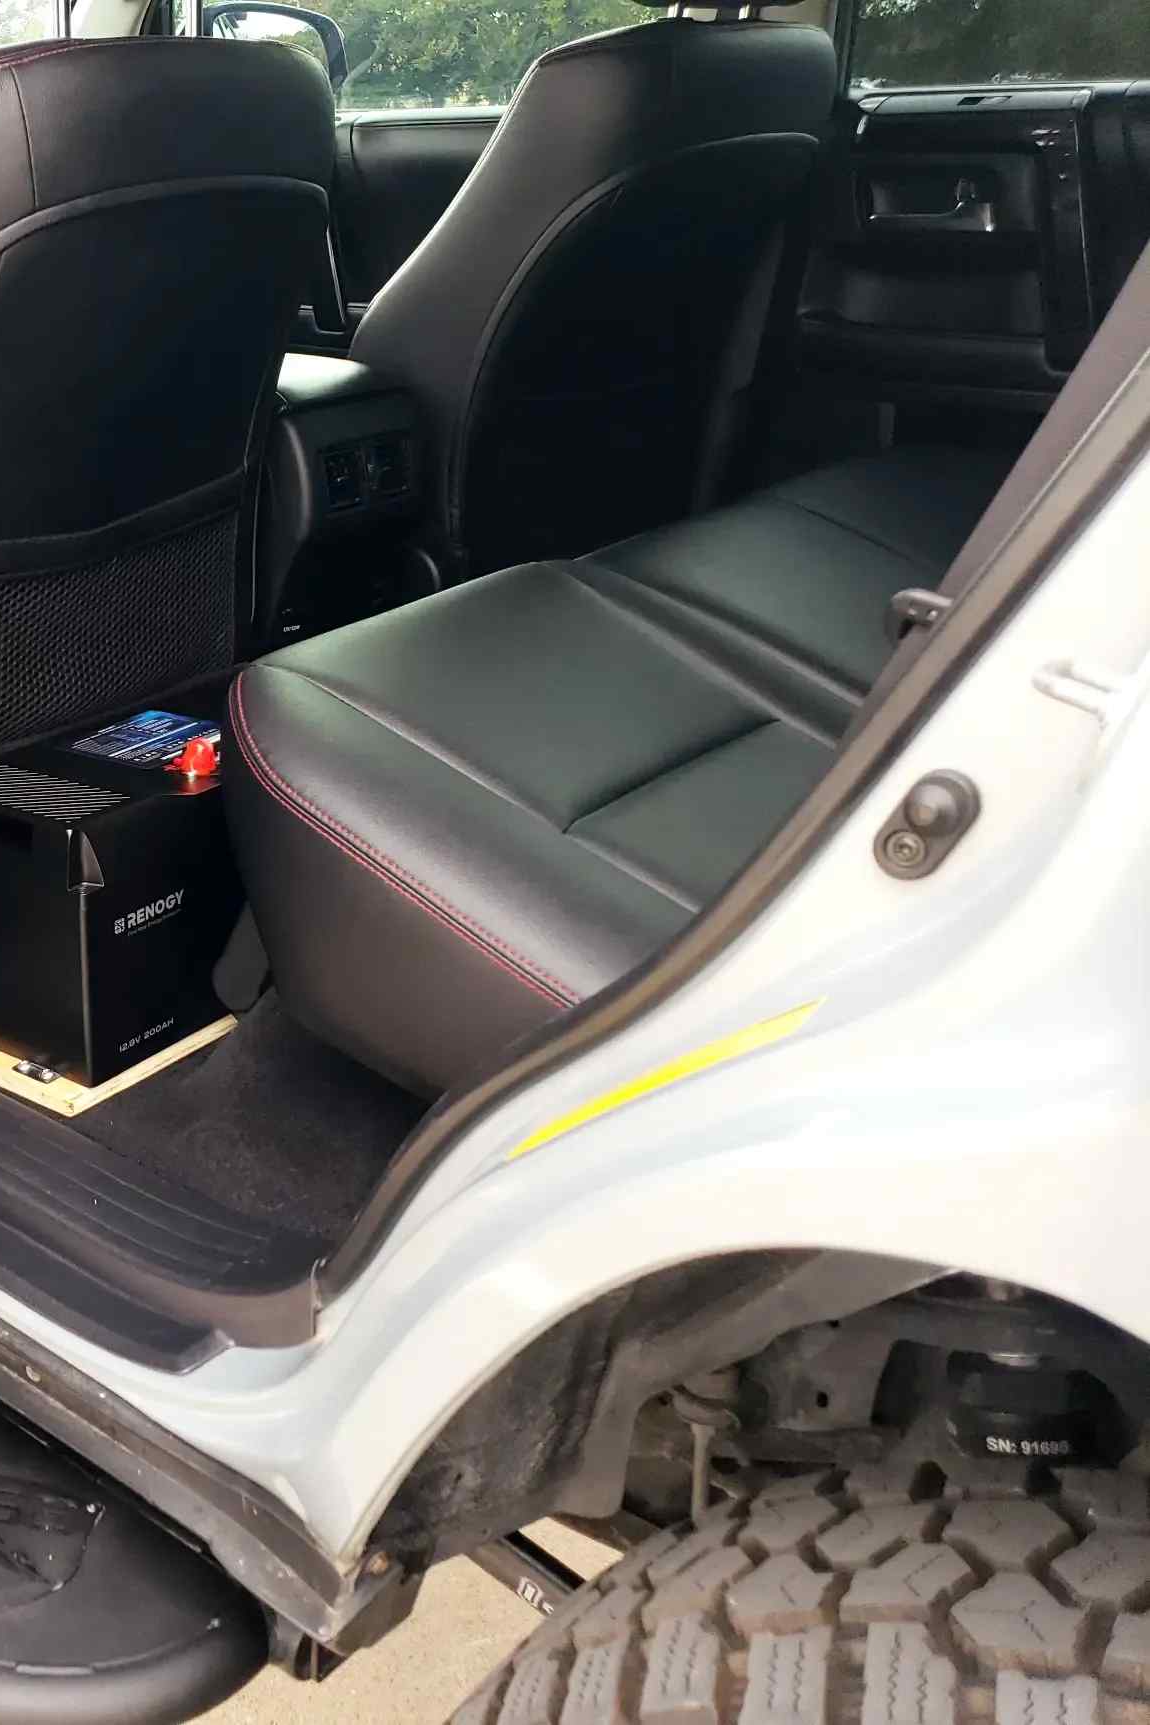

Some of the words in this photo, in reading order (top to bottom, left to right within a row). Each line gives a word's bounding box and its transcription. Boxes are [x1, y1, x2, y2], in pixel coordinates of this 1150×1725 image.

[127, 888, 184, 929] RENOGY
[144, 1016, 174, 1040] 200AH
[985, 1436, 1017, 1454] SN:
